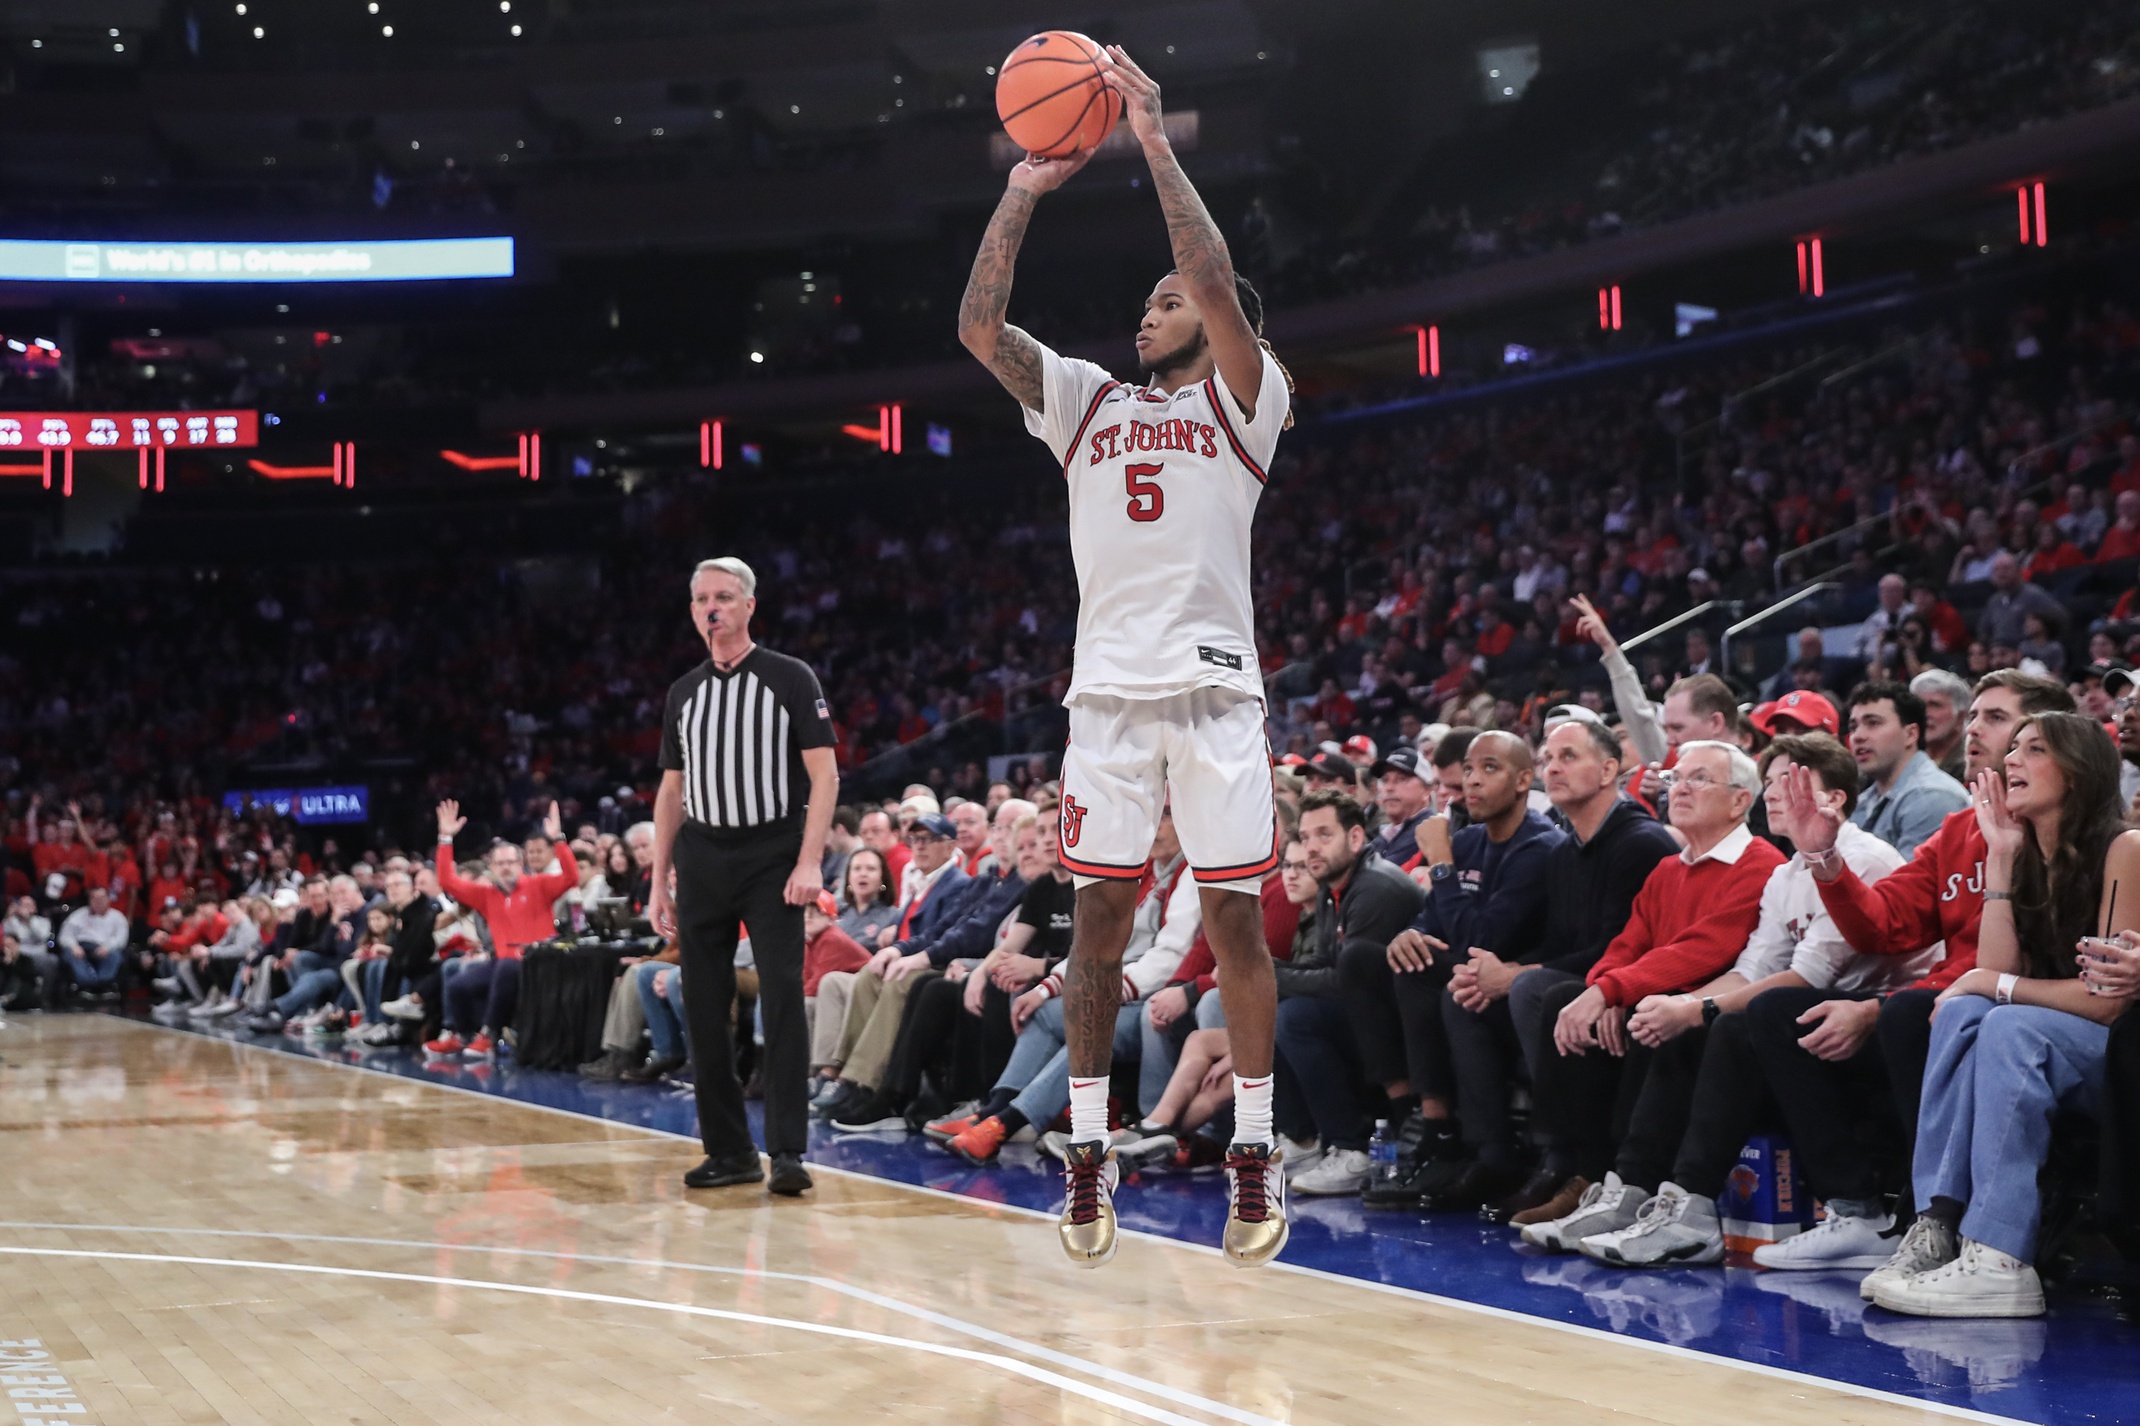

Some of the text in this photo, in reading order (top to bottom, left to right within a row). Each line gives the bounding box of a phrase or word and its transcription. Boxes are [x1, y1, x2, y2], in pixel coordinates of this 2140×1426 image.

[1090, 418, 1218, 466] ST. JOHN'S
[1125, 462, 1164, 522] 5
[301, 794, 361, 815] ULTRA
